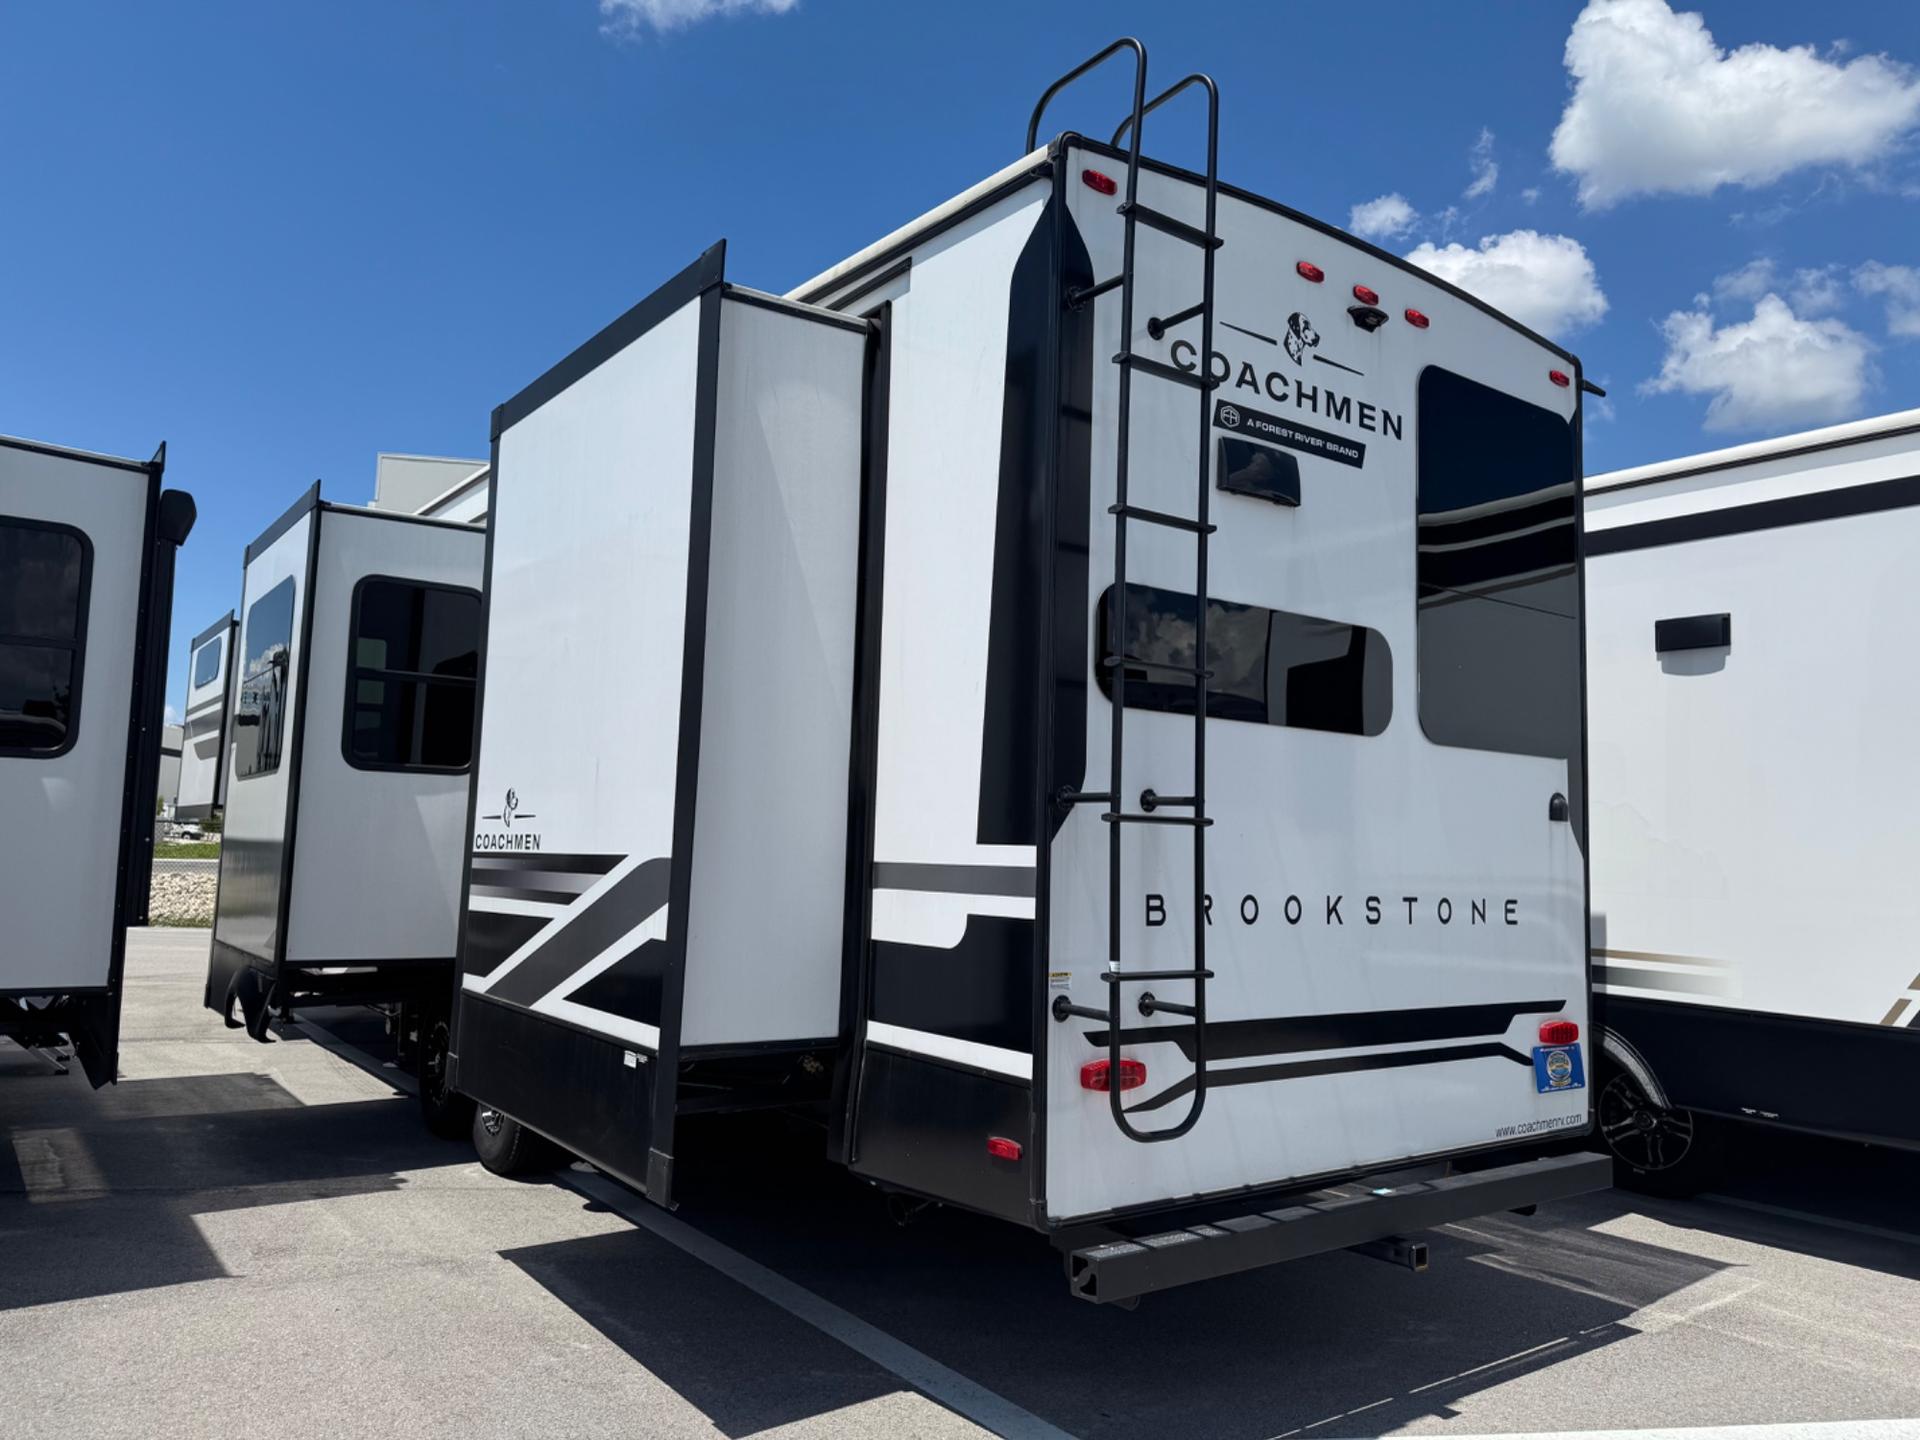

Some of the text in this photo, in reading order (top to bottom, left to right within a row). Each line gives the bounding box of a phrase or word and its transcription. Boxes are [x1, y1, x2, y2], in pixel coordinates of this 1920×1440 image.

[1170, 339, 1402, 441] COACHMEN
[1246, 418, 1255, 427] A
[1255, 420, 1294, 440] FOREST
[1326, 441, 1360, 459] BRAND
[475, 833, 542, 851] COACHMEN
[1494, 1113, 1582, 1138] www.coachmenrv.com
